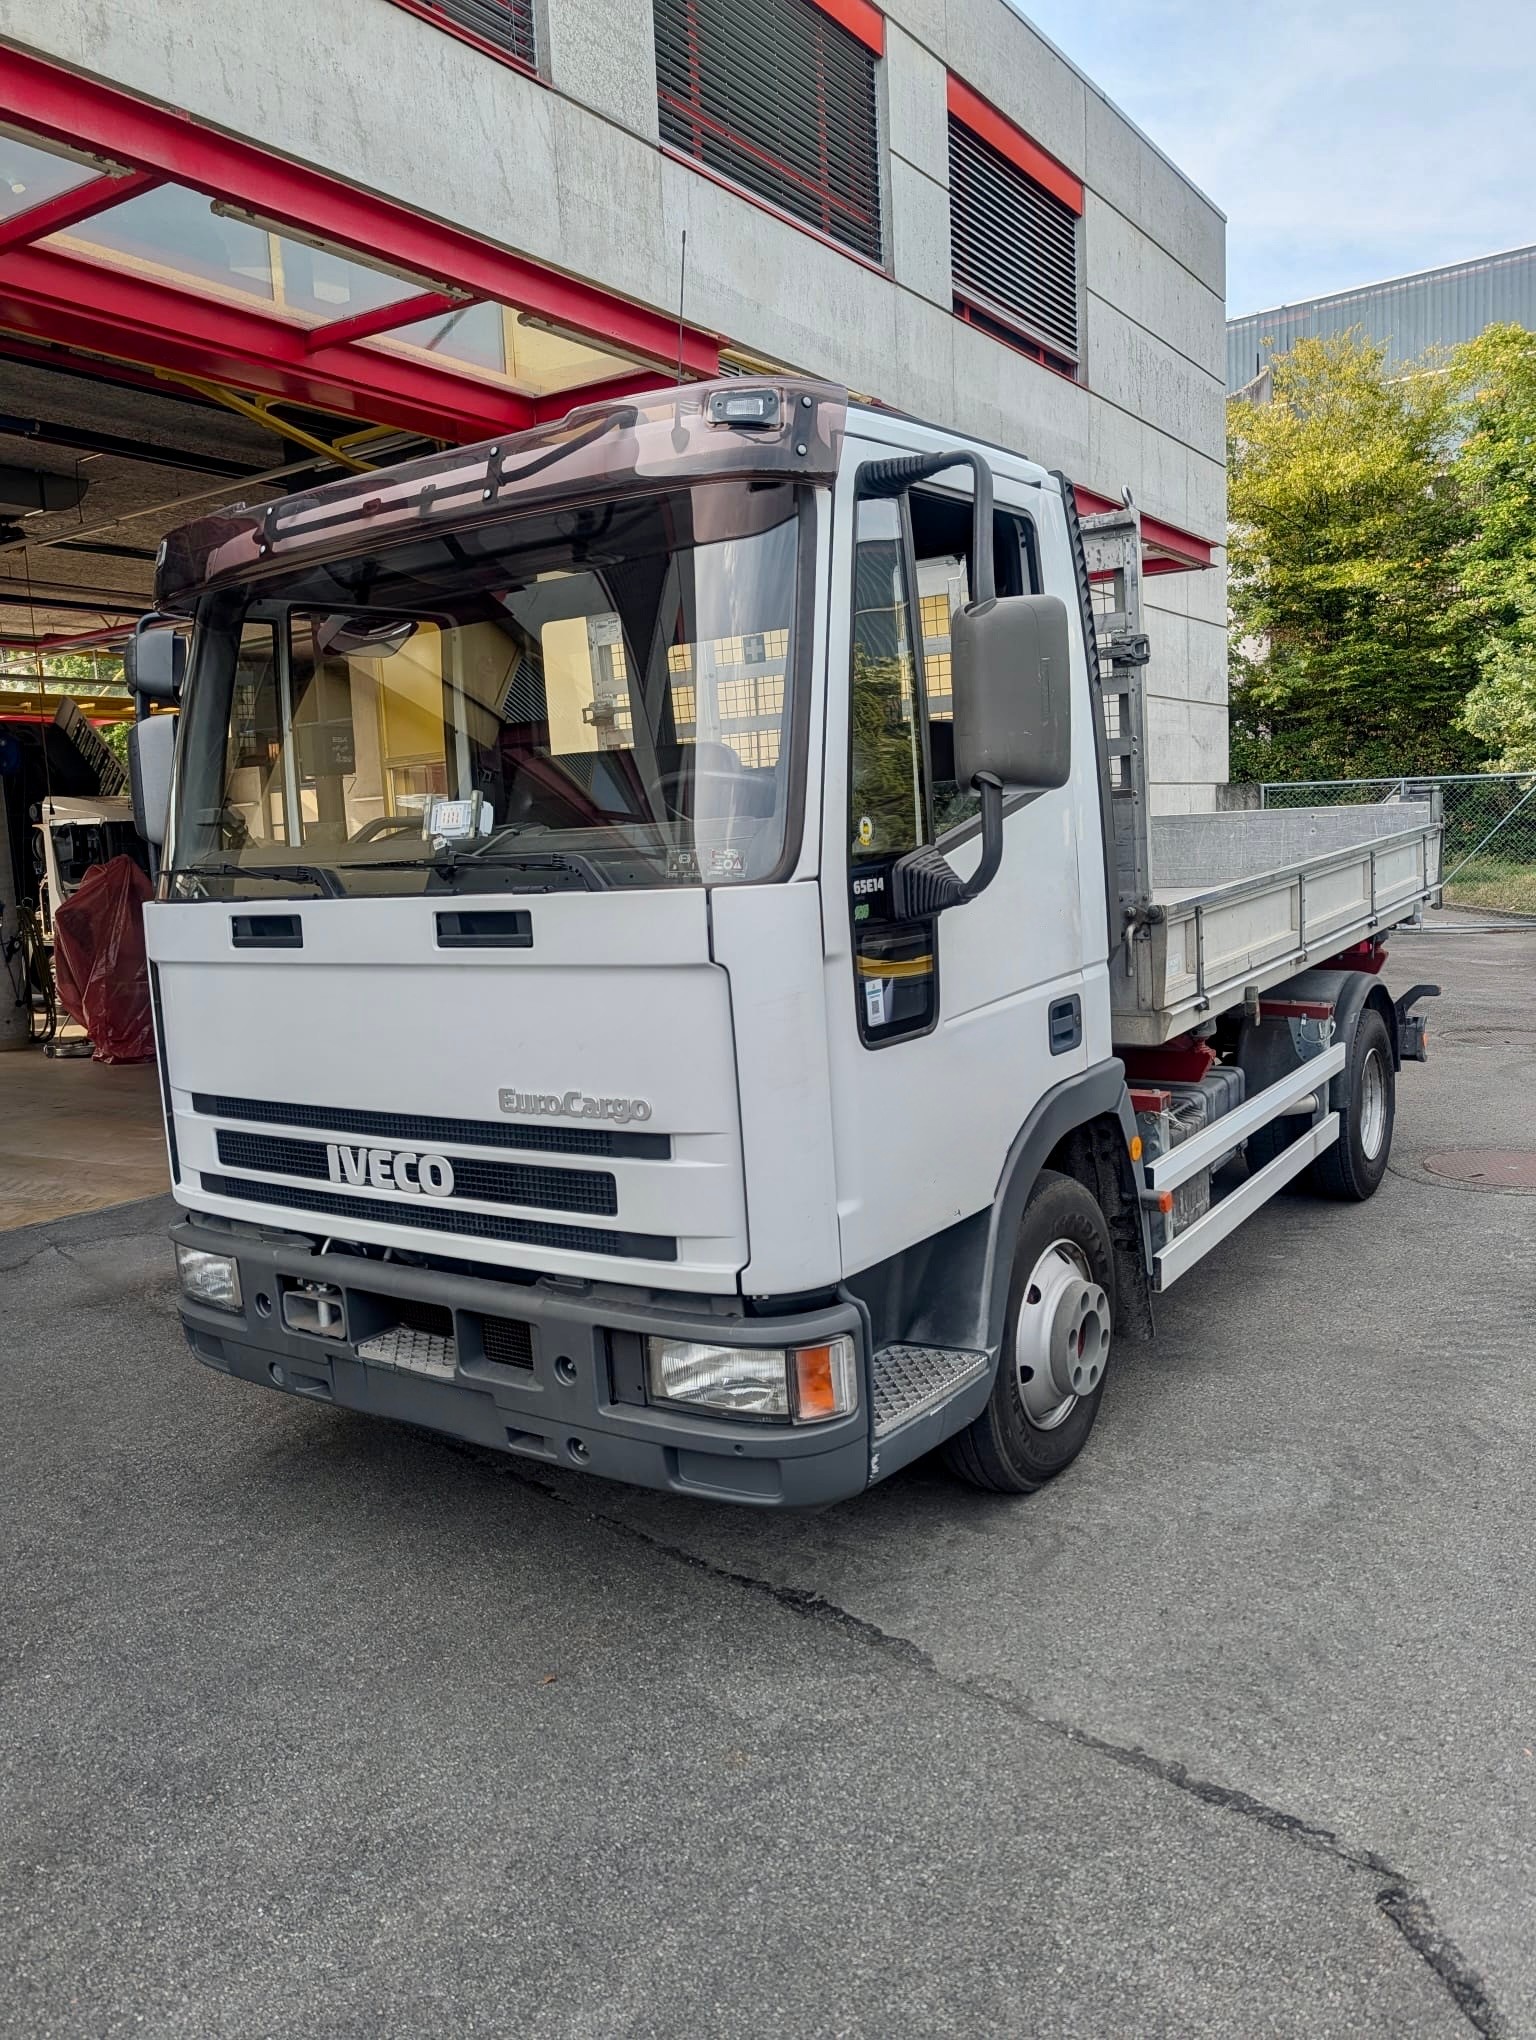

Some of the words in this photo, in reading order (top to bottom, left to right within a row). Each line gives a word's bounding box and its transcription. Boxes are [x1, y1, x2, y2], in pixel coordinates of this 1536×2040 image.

[853, 876, 884, 894] 65E14
[498, 1087, 652, 1123] EuroCargo
[326, 1144, 455, 1197] IVECO
